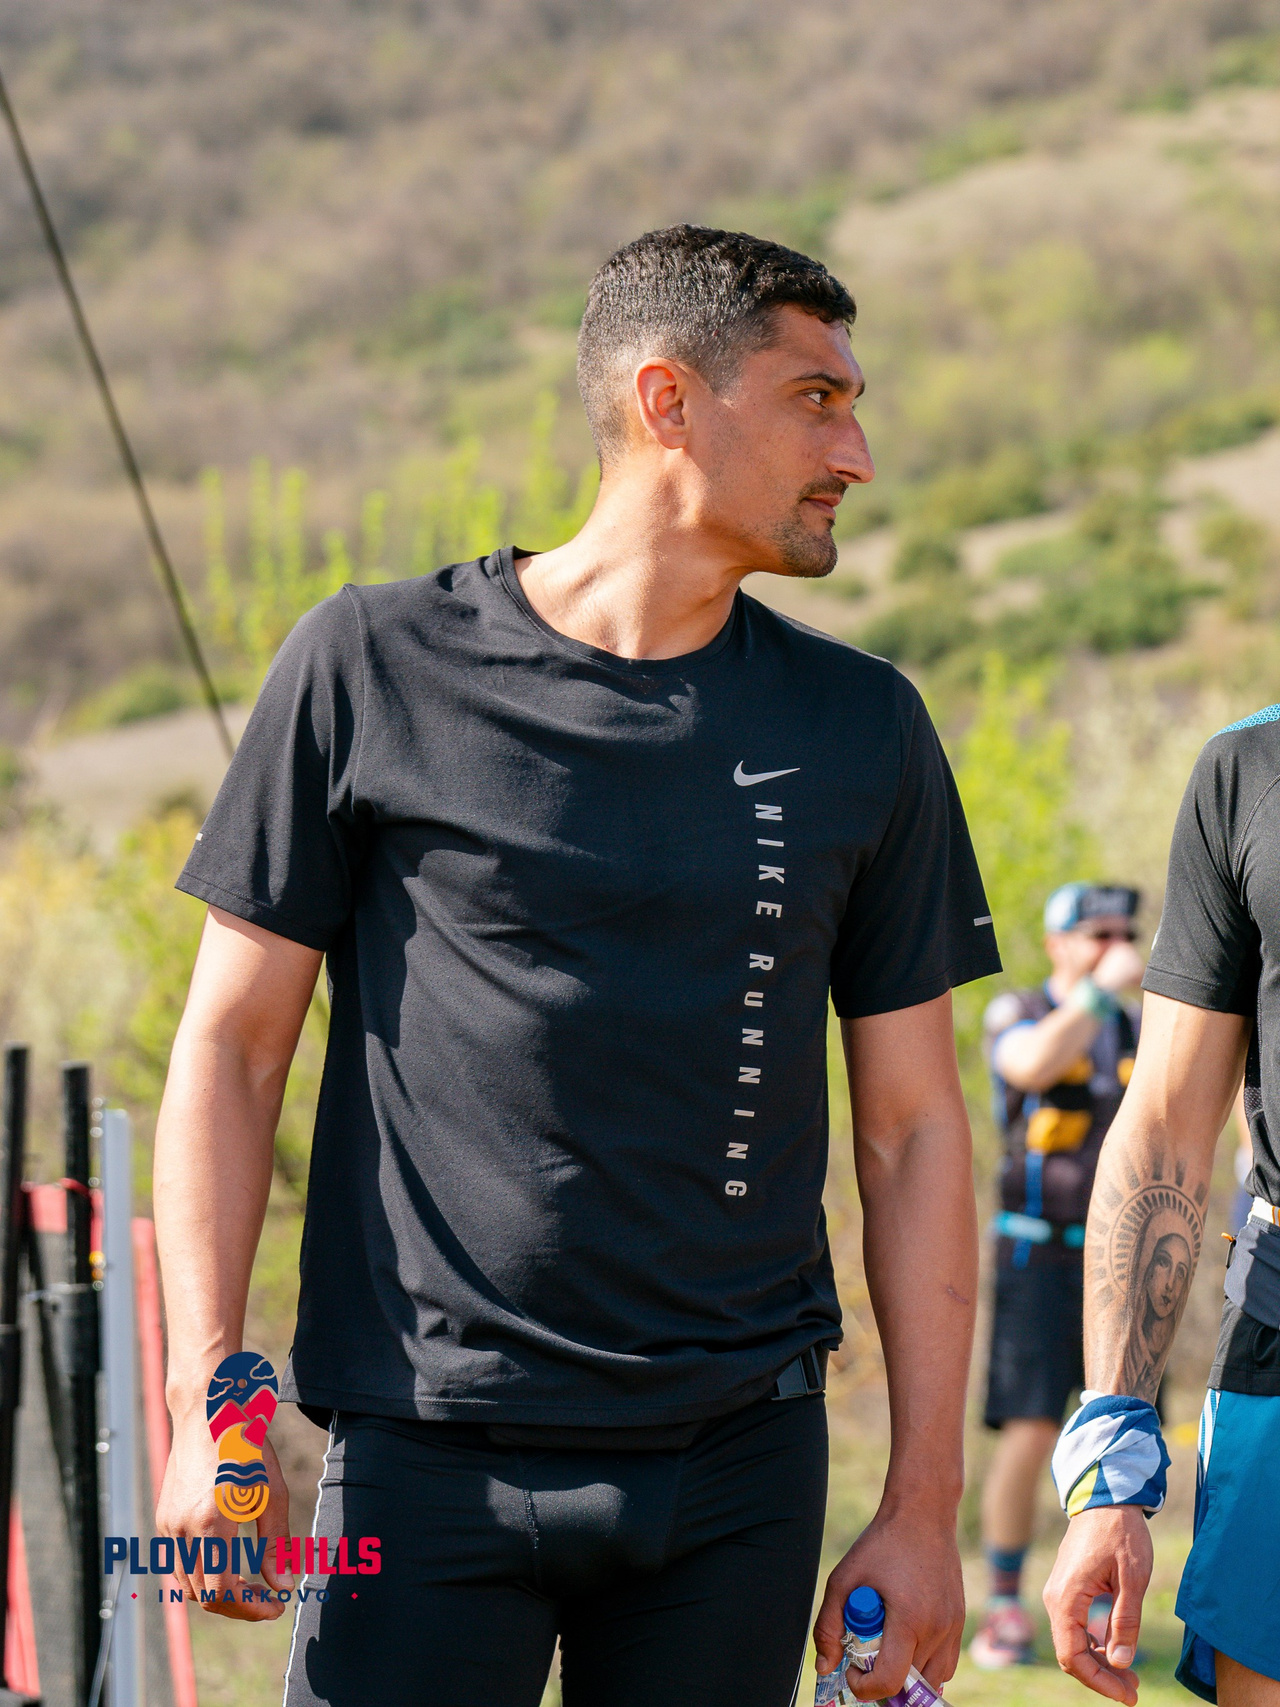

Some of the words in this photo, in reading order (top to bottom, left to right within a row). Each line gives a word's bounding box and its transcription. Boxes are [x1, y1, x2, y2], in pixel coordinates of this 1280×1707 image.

[754, 803, 785, 919] NIKE
[724, 953, 775, 1197] RUNNING
[907, 1686, 924, 1706] MINT
